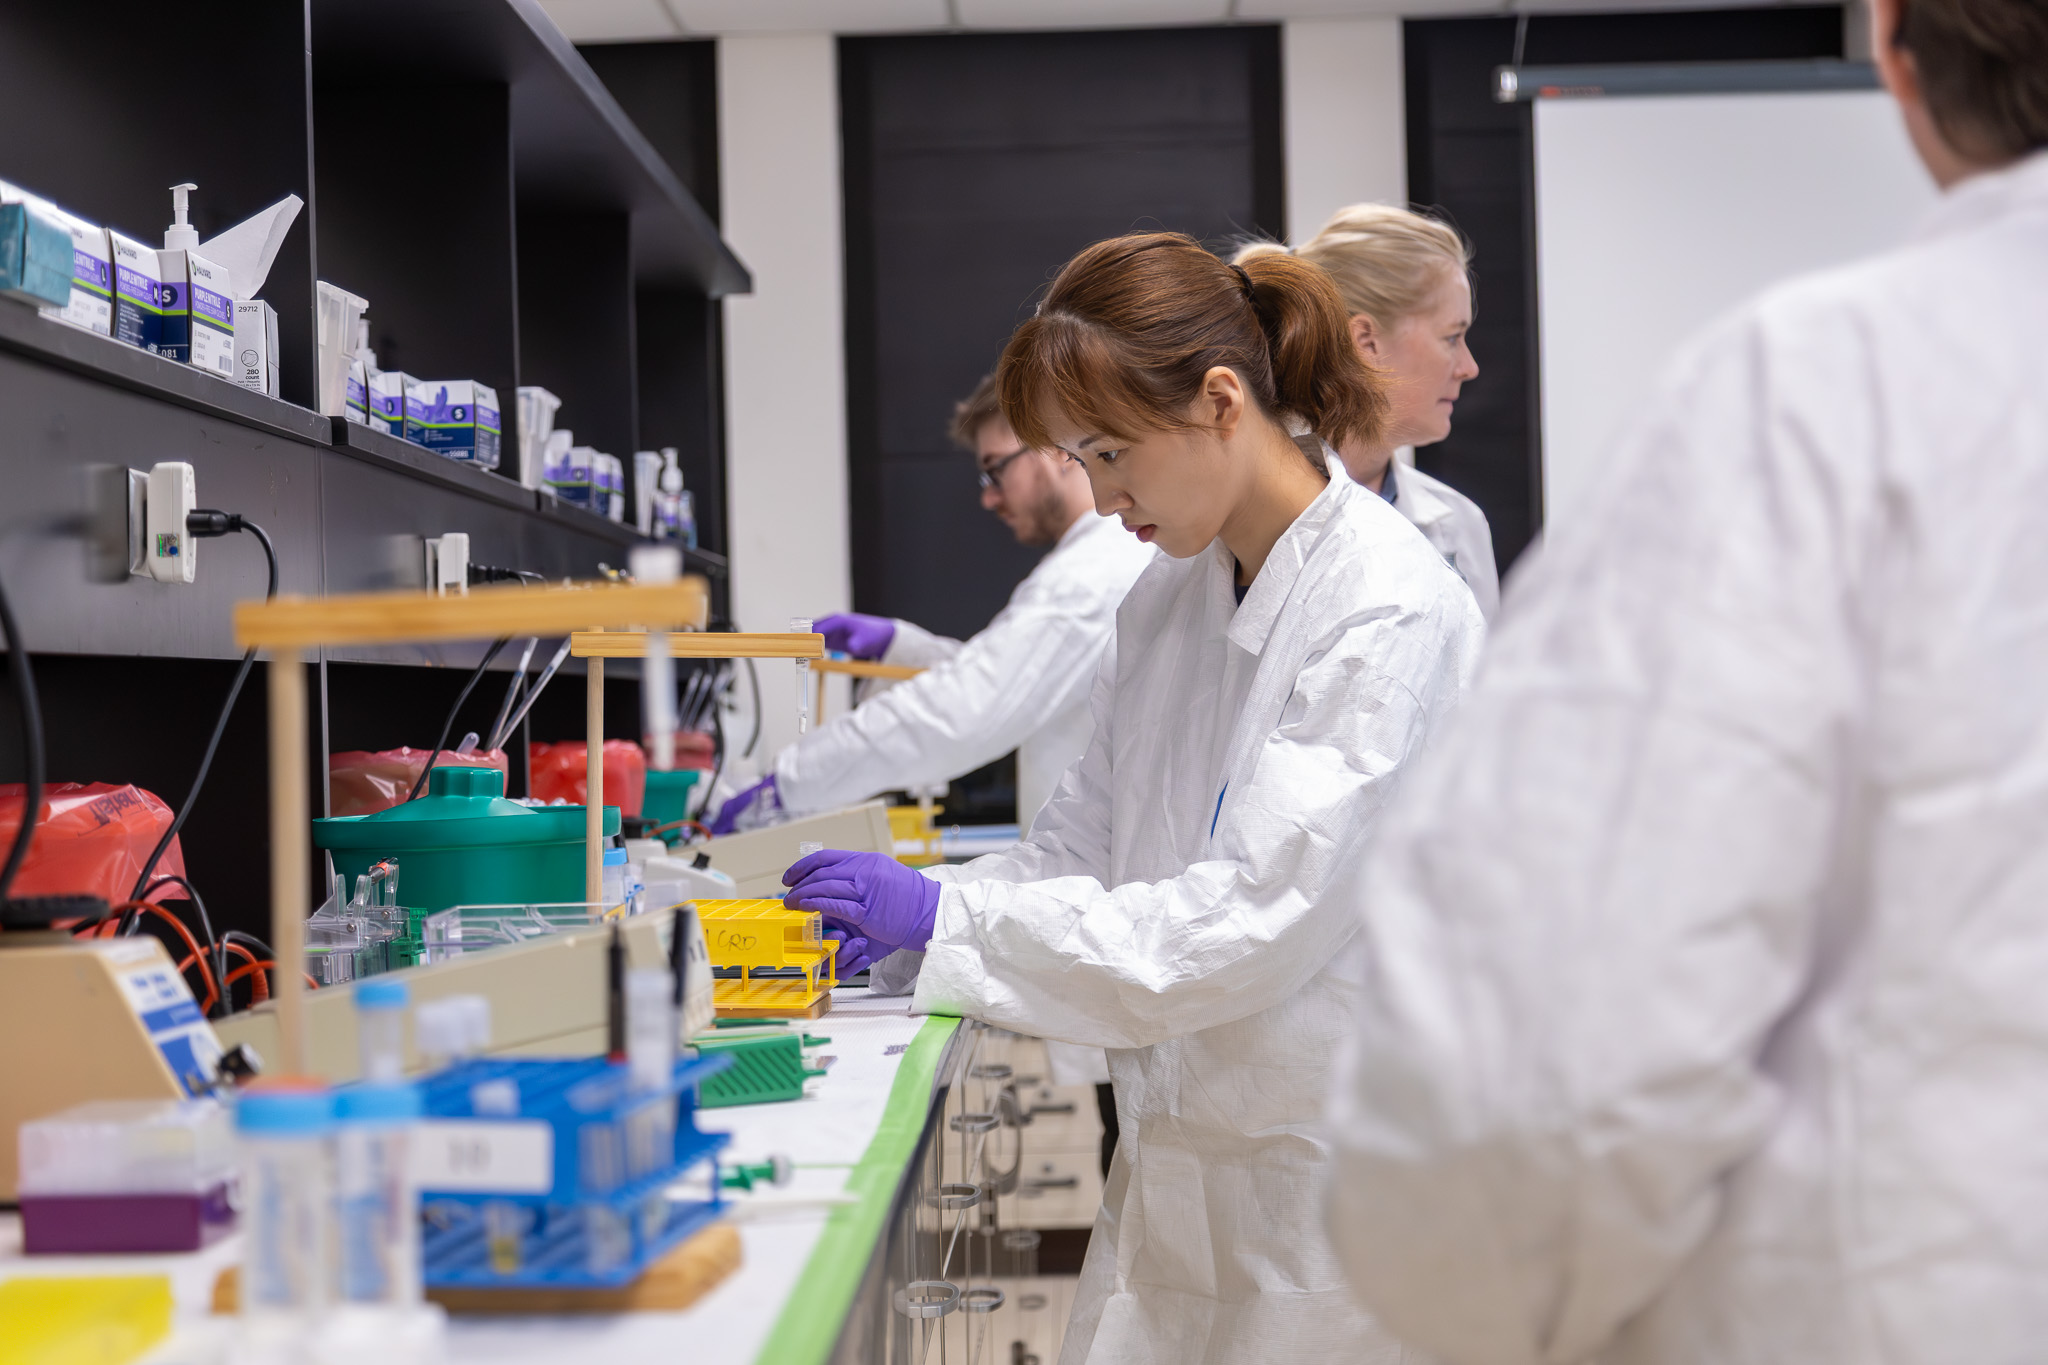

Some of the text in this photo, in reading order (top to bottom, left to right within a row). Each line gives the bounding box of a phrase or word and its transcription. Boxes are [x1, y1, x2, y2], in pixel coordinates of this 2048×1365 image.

[162, 290, 171, 303] S
[227, 304, 231, 318] S
[454, 407, 464, 420] S
[705, 928, 757, 951] ICRO
